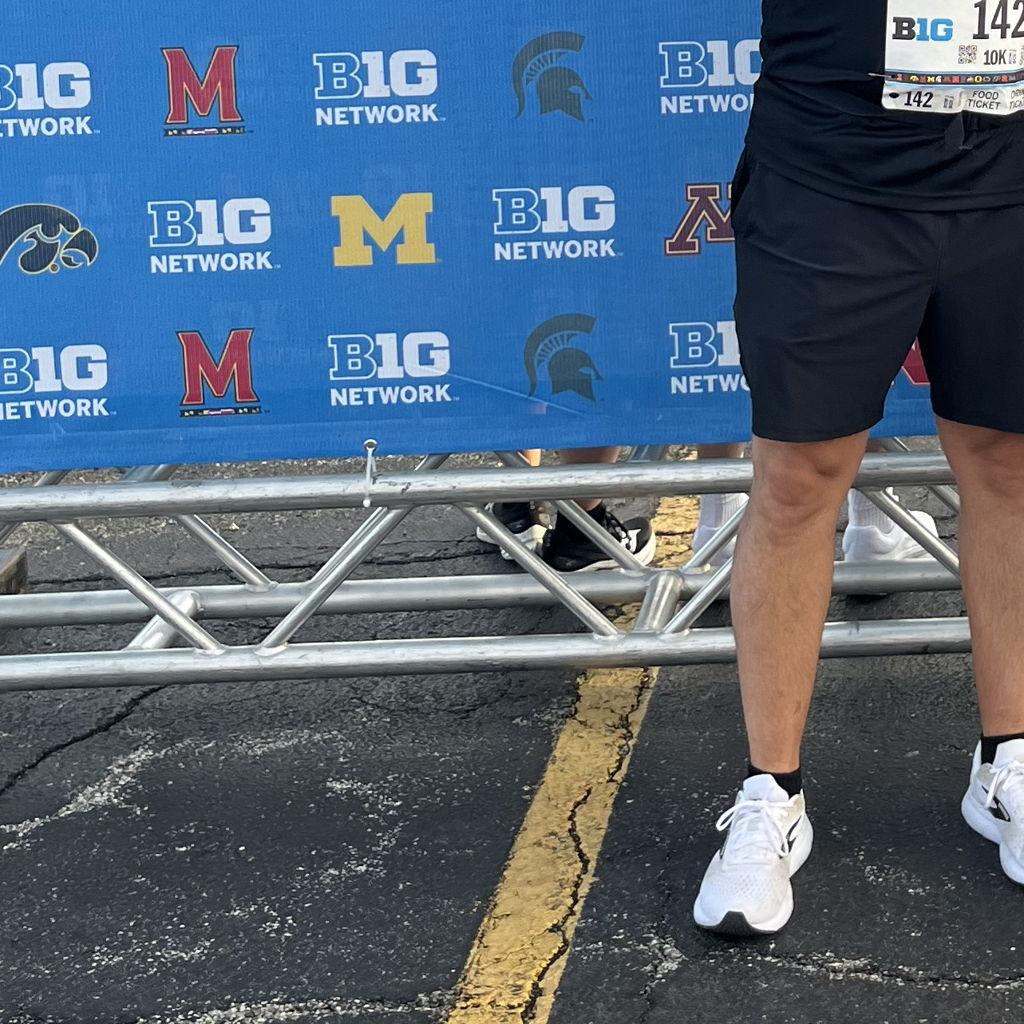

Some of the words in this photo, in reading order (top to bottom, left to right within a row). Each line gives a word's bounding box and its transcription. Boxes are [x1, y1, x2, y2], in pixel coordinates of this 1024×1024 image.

[984, 49, 1007, 65] 10K
[162, 45, 241, 125] M
[661, 93, 754, 114] NETWO
[904, 91, 934, 108] 142
[967, 99, 1001, 110] TICKET
[972, 90, 999, 101] FOOD
[316, 105, 438, 125] NETWORK
[0, 116, 92, 137] TWORK
[330, 192, 438, 267] M
[495, 240, 615, 259] NETWORK
[151, 252, 272, 273] NETWORK
[176, 328, 257, 406] M
[671, 374, 751, 394] NETW
[331, 385, 450, 405] NETWORK
[0, 398, 109, 420] ETWORK
